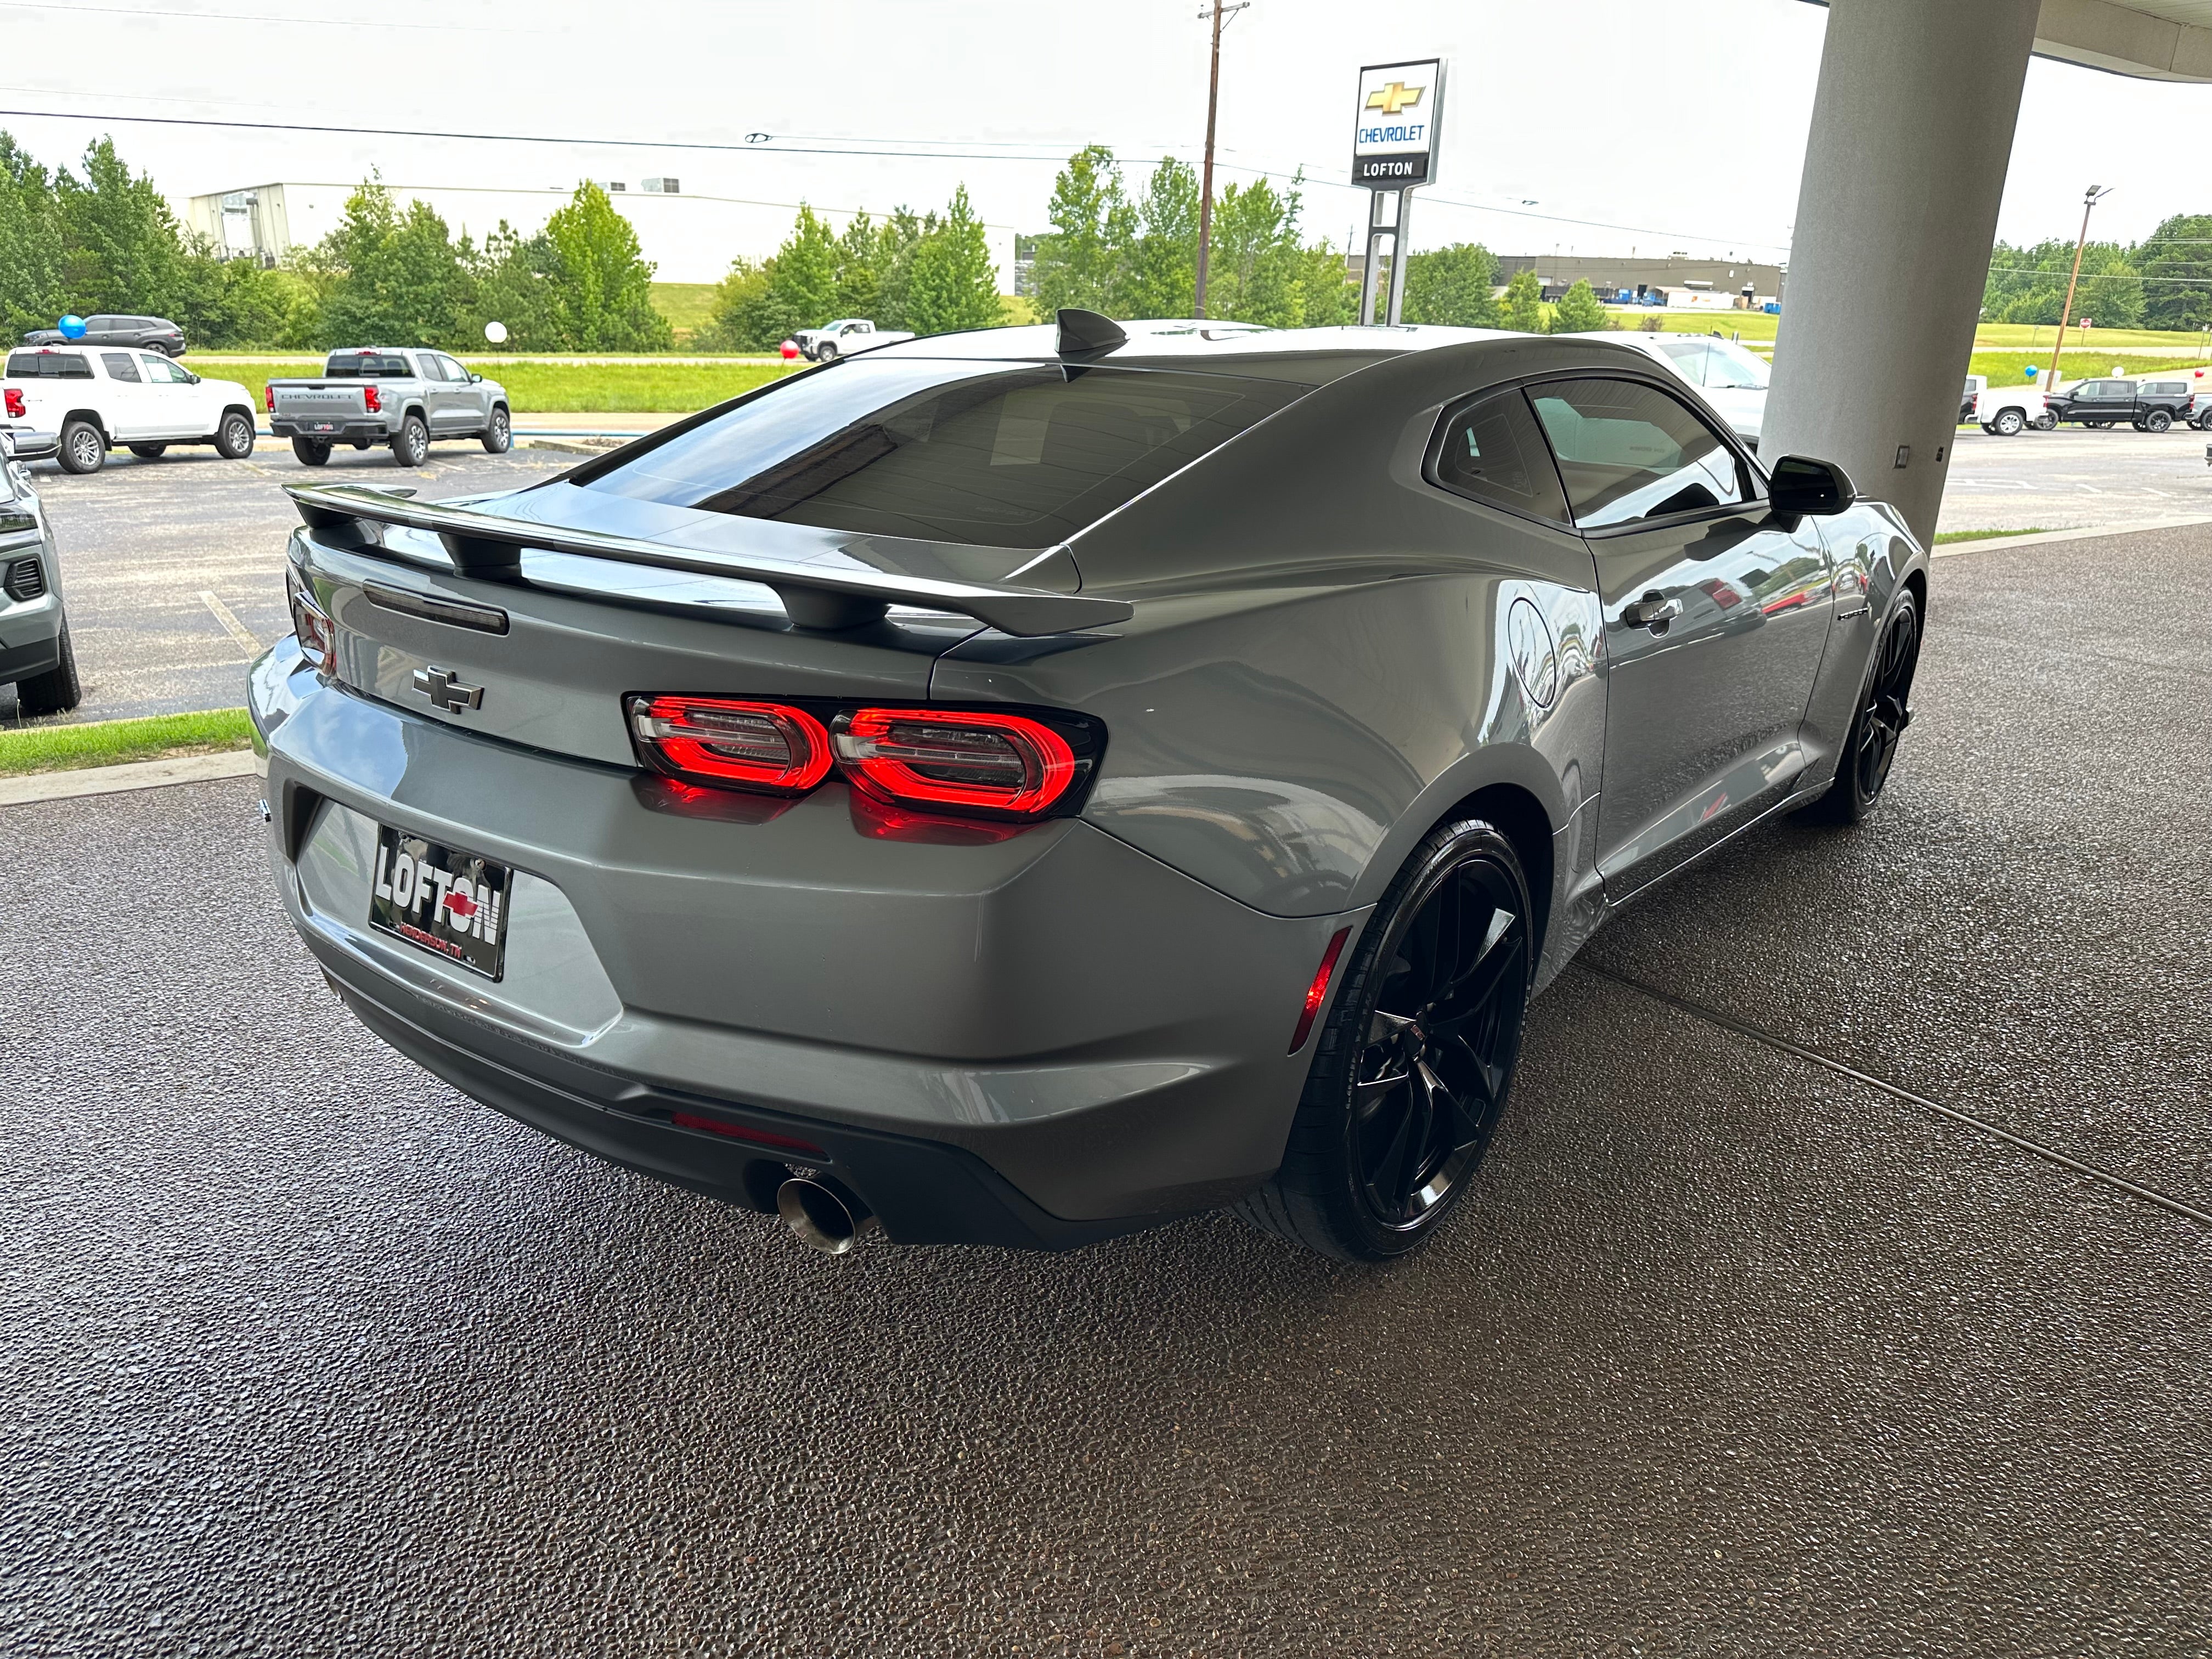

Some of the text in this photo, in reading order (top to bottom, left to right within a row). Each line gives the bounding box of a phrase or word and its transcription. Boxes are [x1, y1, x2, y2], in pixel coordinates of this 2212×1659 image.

[1359, 125, 1425, 143] CHEVROLET
[1363, 162, 1413, 177] LOFTON
[375, 843, 501, 945] LOFTON
[450, 943, 462, 958] TN
